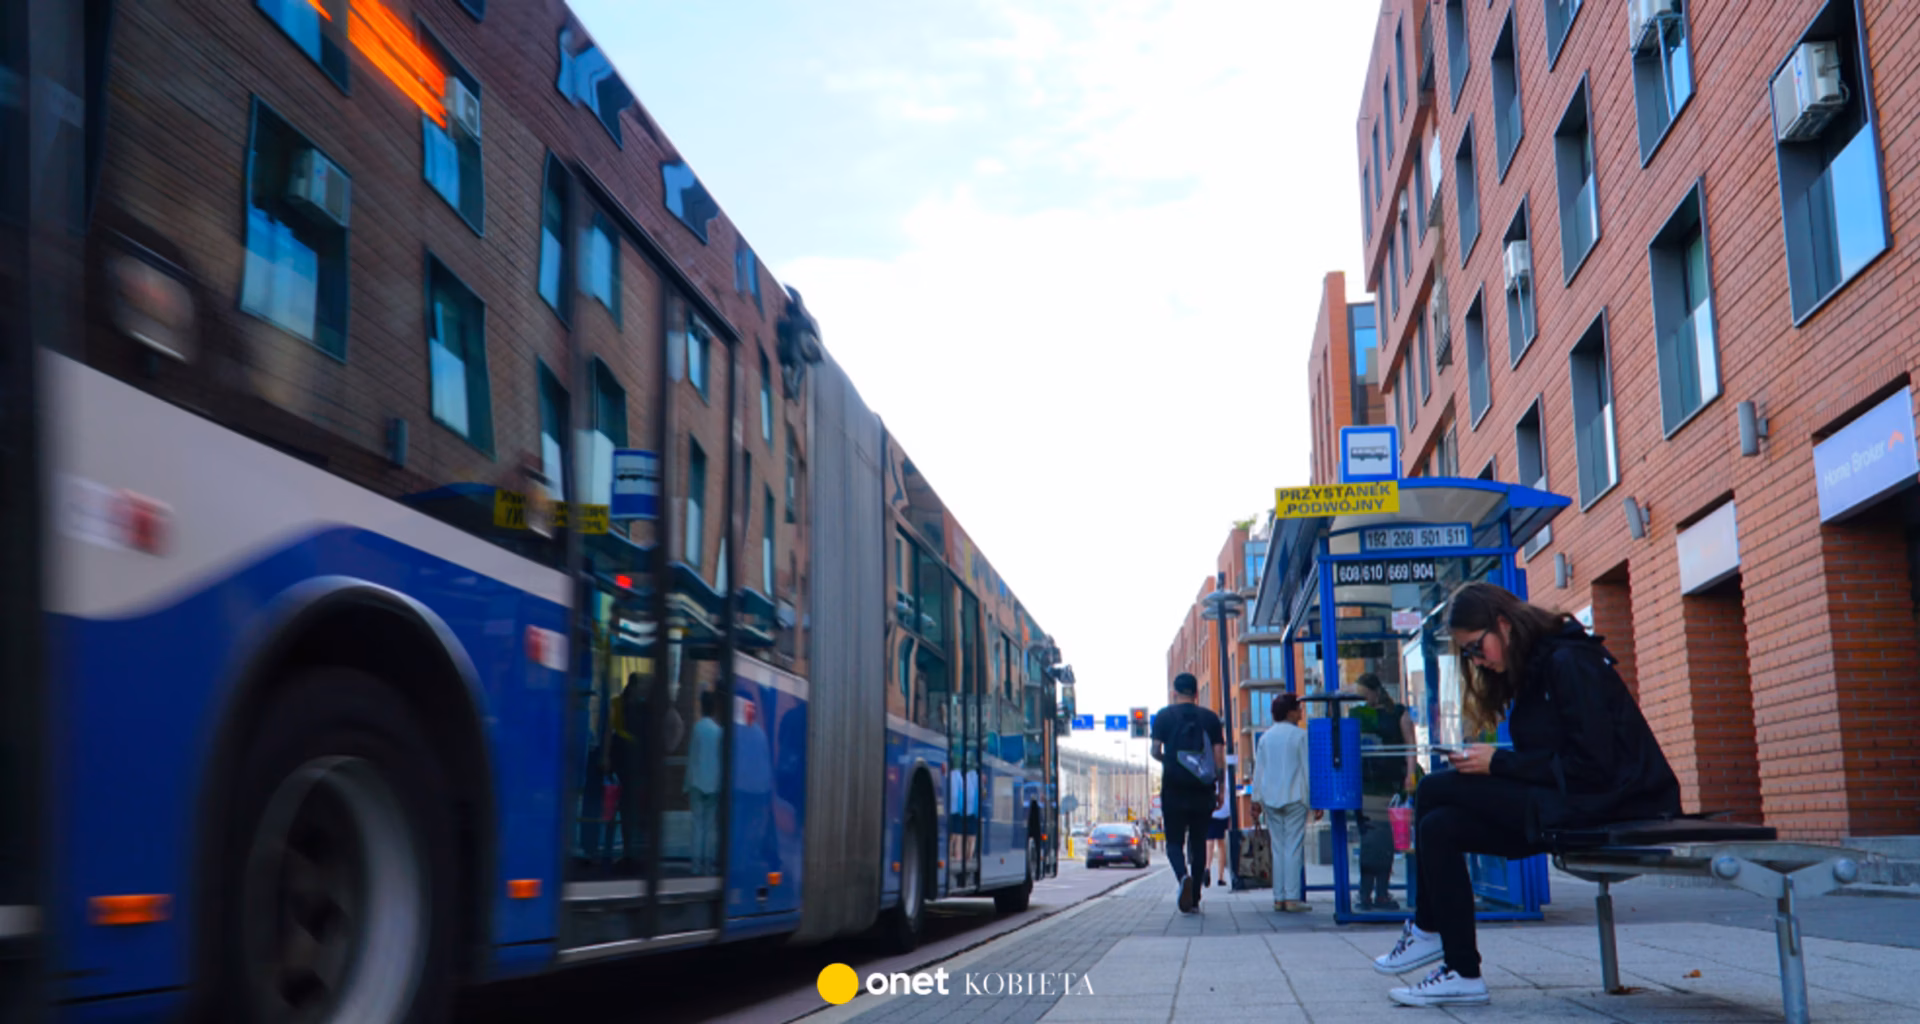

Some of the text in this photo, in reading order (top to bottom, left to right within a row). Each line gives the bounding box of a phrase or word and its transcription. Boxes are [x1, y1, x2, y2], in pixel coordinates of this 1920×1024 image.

[1280, 485, 1391, 501] PRZYSTANEK
[1368, 528, 1465, 547] 192 208 501 511
[1362, 564, 1383, 581] 610
[1388, 563, 1409, 581] 669
[1412, 562, 1434, 579] 904
